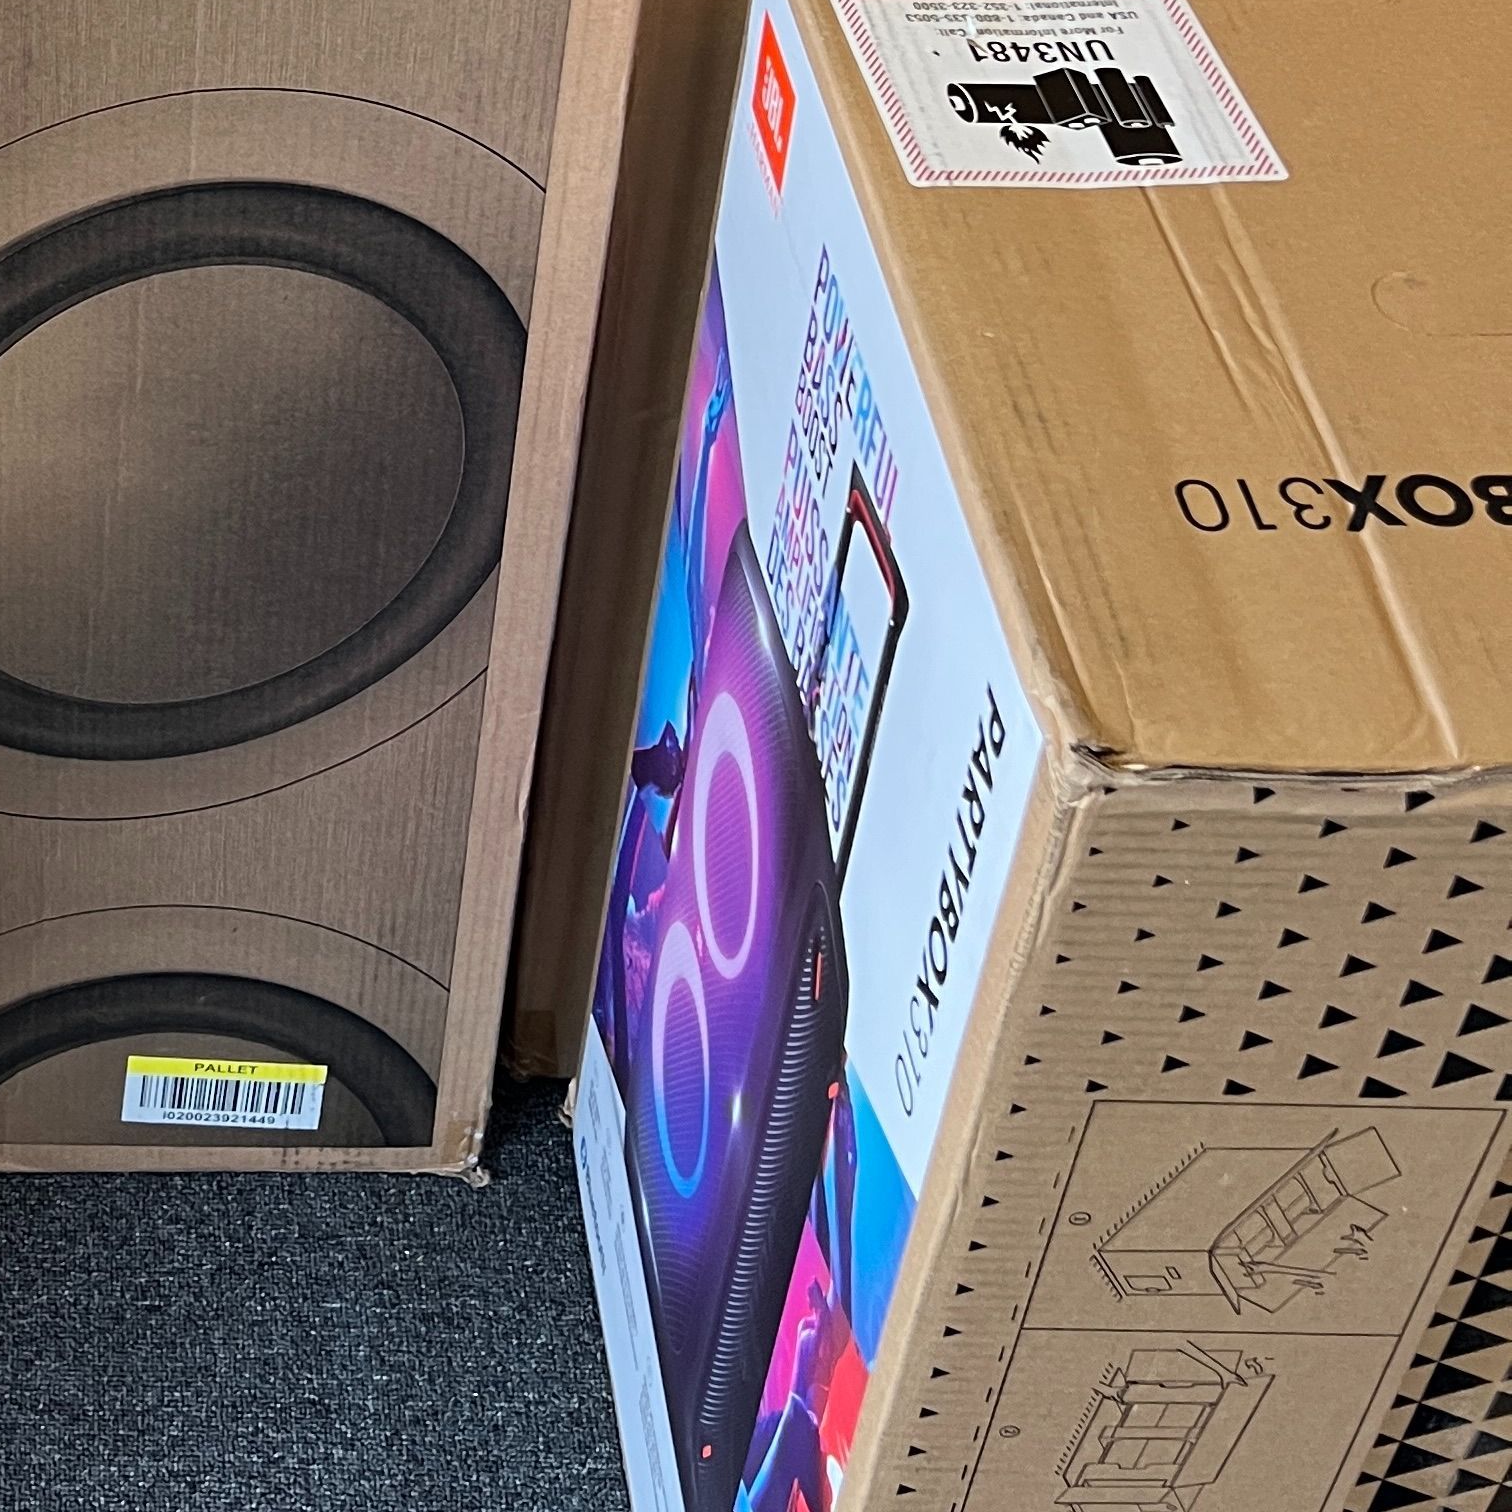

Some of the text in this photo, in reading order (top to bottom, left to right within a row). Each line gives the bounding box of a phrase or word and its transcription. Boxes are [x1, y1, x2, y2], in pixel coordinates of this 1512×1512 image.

[1079, 11, 1104, 20] and
[1114, 10, 1138, 20] USA
[1060, 26, 1097, 36] More
[1105, 25, 1124, 35] For
[966, 38, 1116, 63] UN3481
[804, 305, 843, 456] BASS
[795, 361, 833, 499] BOOST
[894, 682, 1007, 1118] PARTYBOX310
[194, 1062, 259, 1075] PALLET
